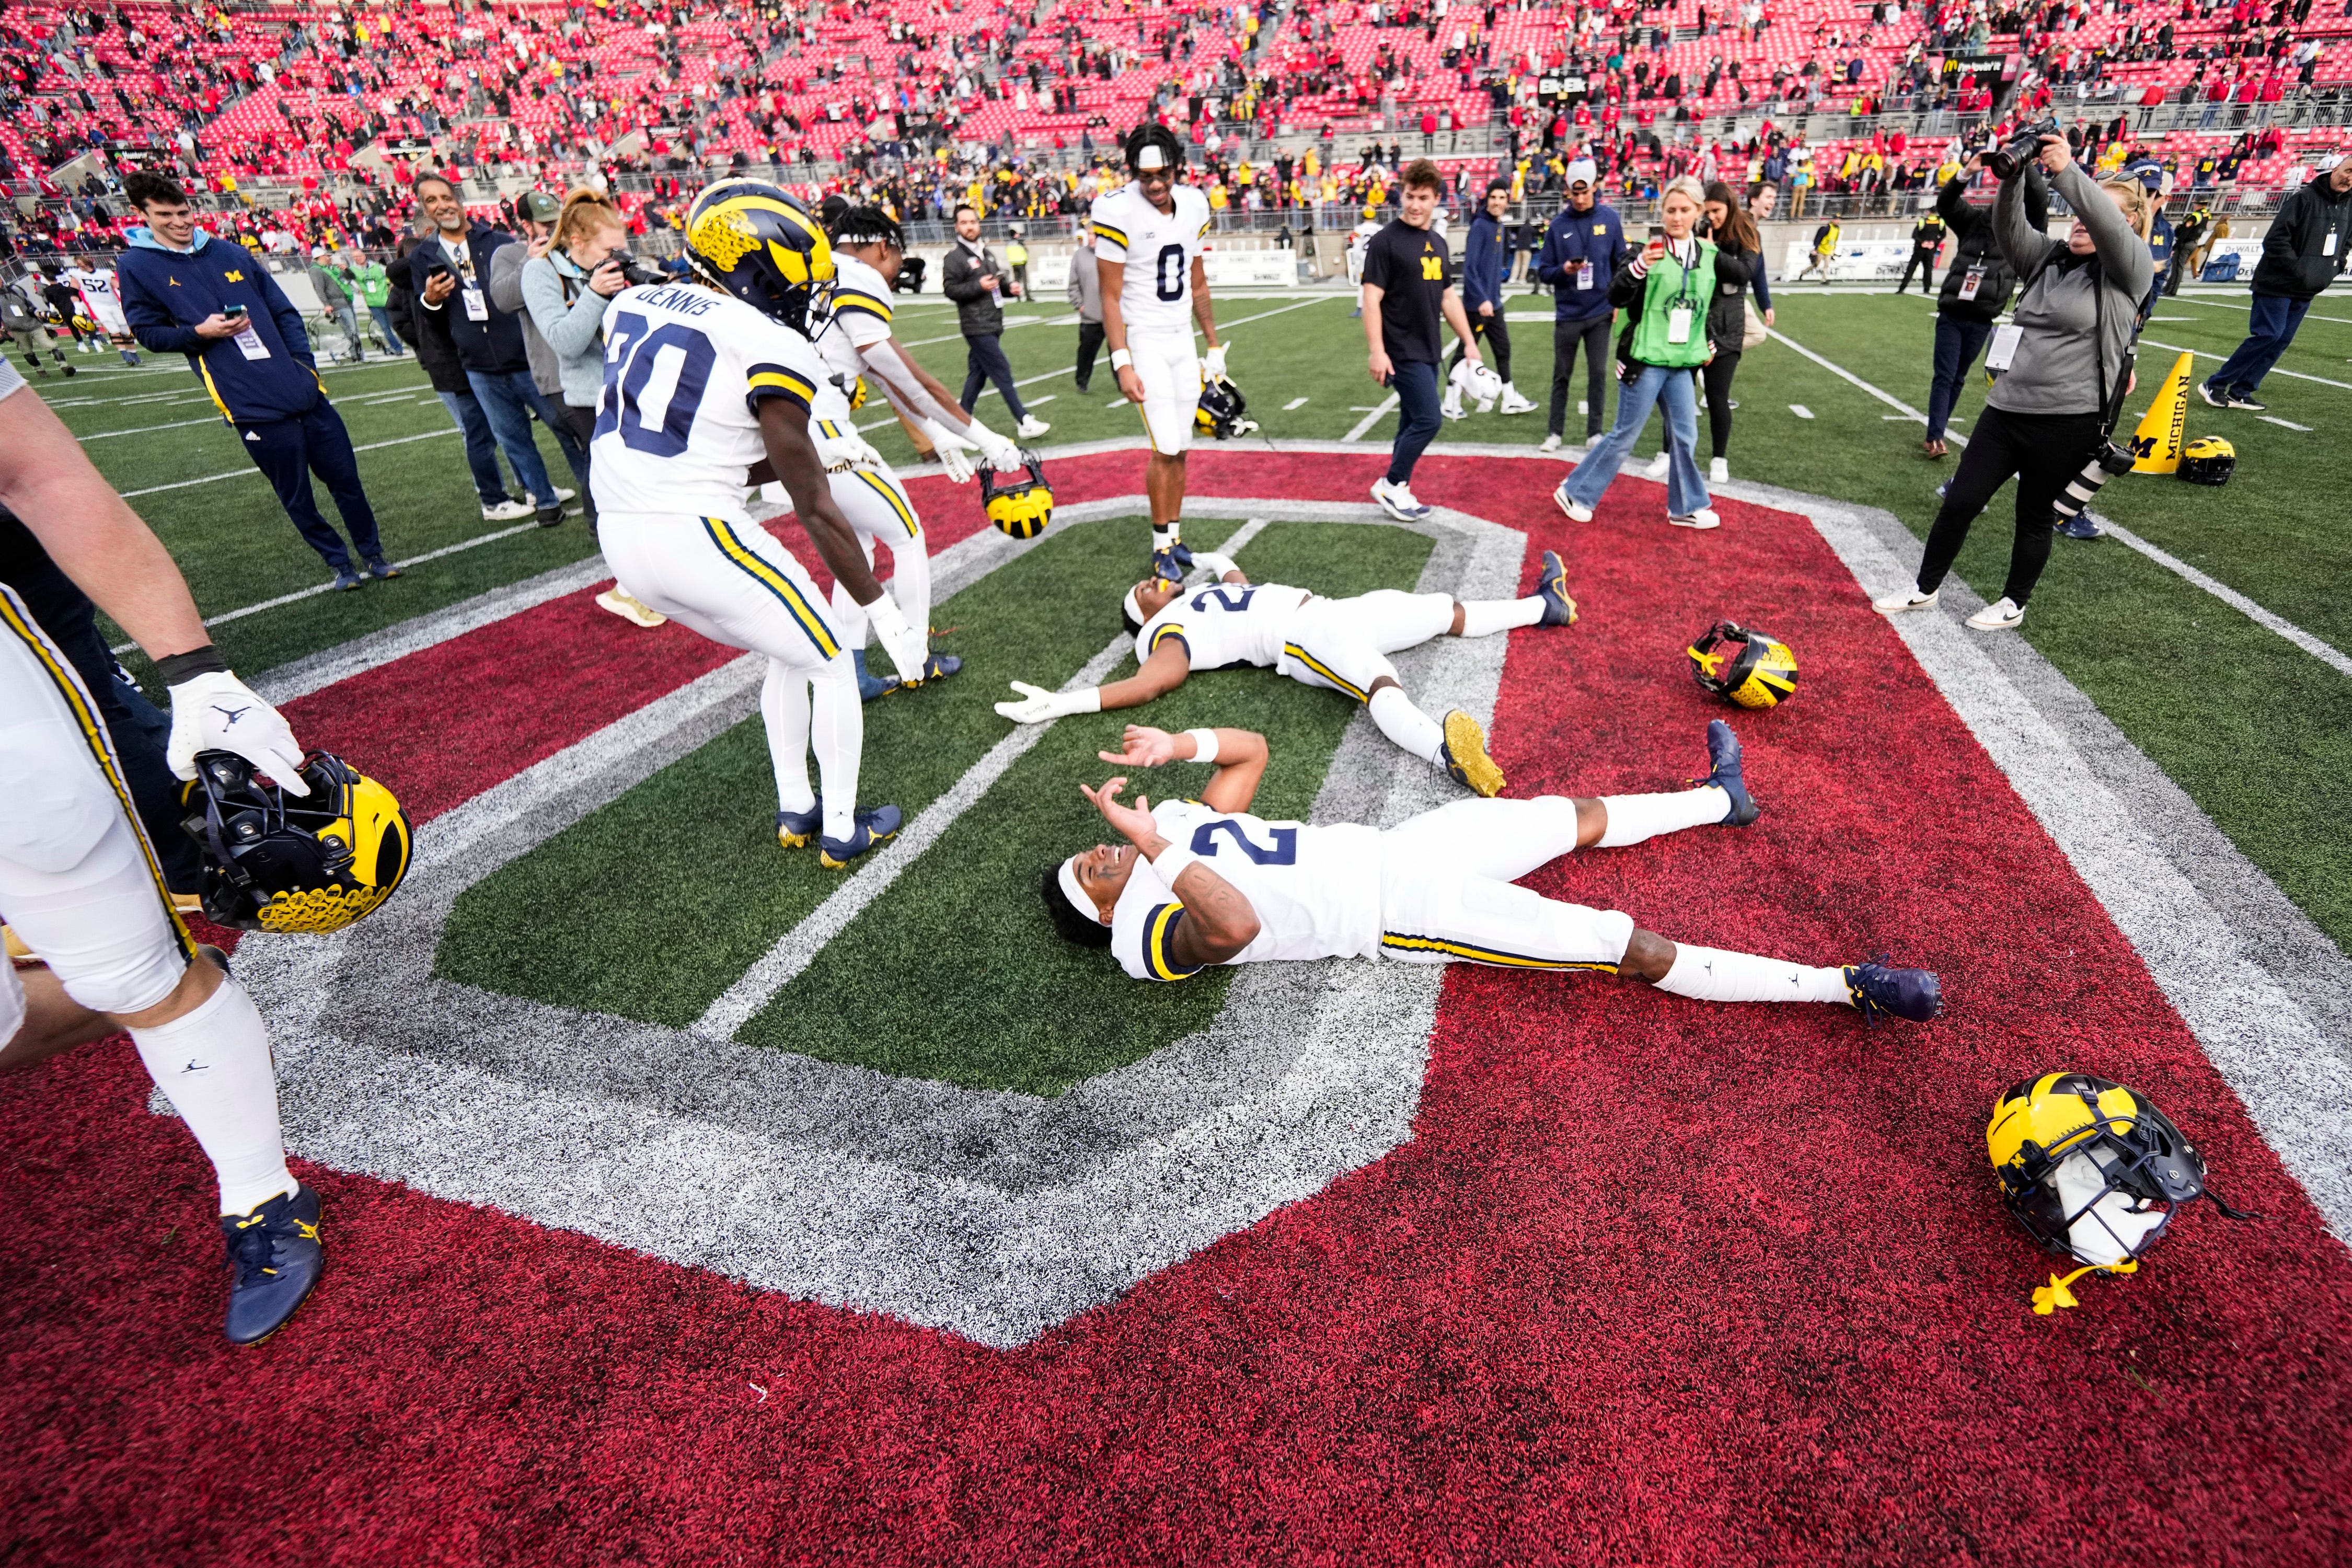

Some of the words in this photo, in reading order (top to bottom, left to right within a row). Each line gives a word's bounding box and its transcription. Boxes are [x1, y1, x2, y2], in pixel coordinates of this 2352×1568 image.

[2200, 160, 2214, 172] 10
[2229, 158, 2239, 169] 9
[2152, 235, 2164, 246] M
[224, 269, 245, 283] M
[1157, 244, 1184, 302] 0
[1420, 256, 1443, 281] M
[82, 279, 109, 293] 52
[2165, 375, 2190, 461] MICHIGAN
[2129, 434, 2159, 459] M
[1190, 819, 1297, 866] 2
[2009, 1152, 2026, 1170] M
